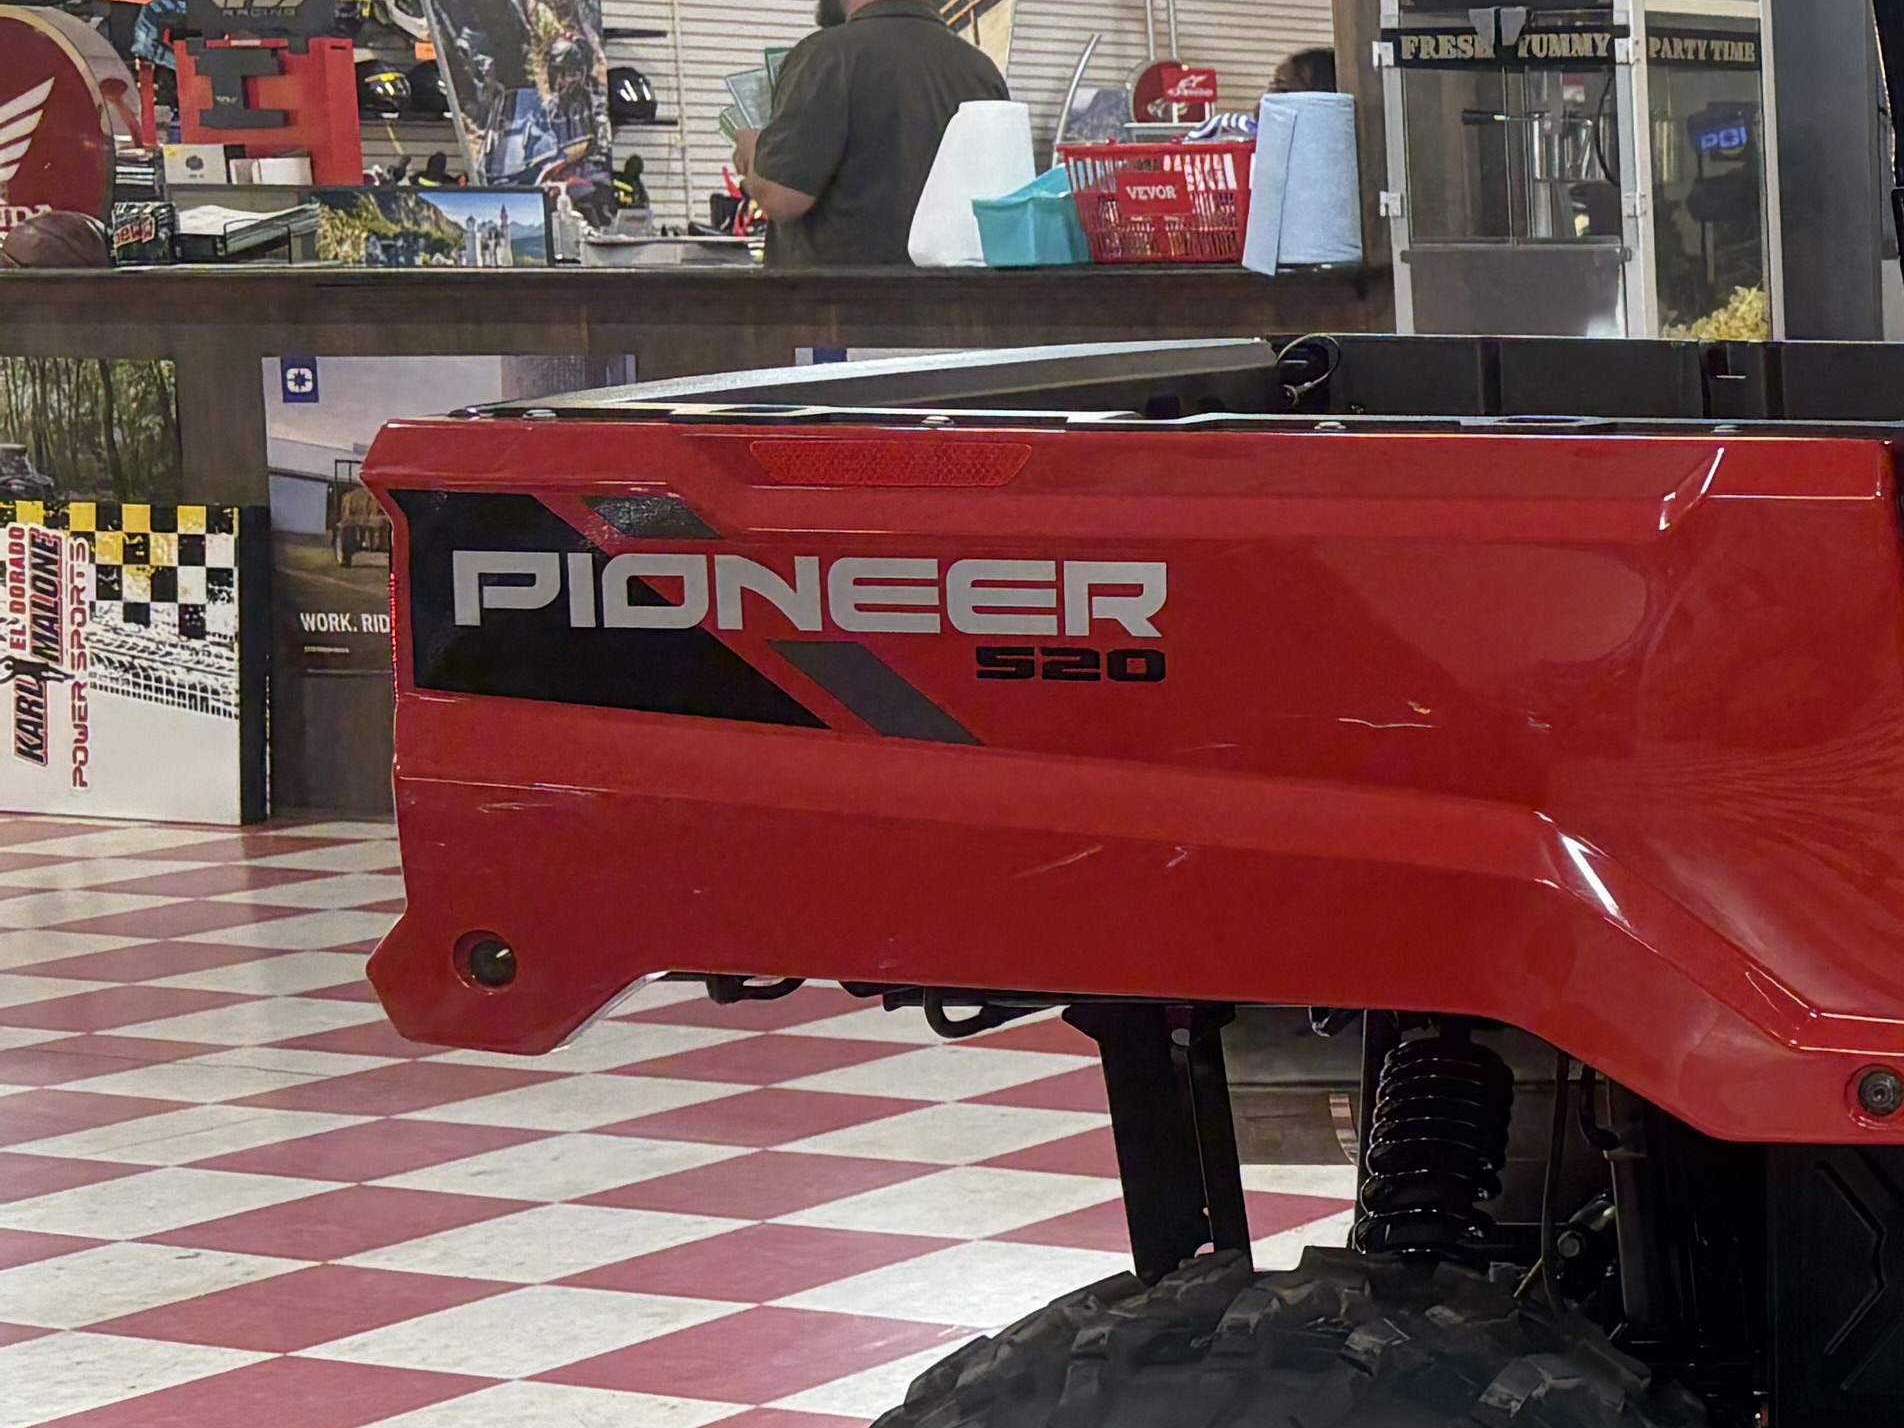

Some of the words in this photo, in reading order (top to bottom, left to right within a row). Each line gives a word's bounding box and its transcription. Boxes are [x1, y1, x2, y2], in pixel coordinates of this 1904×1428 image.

[222, 8, 296, 18] RACING
[1516, 32, 1612, 59] YUMMY
[1647, 37, 1709, 60] PARTY
[1709, 41, 1755, 63] TIME
[1126, 185, 1177, 201] VEVOR
[8, 525, 27, 613] DORADO
[29, 528, 63, 667] MALONE
[69, 538, 88, 672] SPORTS
[452, 550, 1167, 638] PIONEER
[9, 619, 27, 651] EL
[300, 612, 358, 632] WORK.
[361, 613, 391, 633] RID
[976, 646, 1166, 683] 520
[14, 676, 48, 767] KARL
[71, 680, 89, 788] POWER
